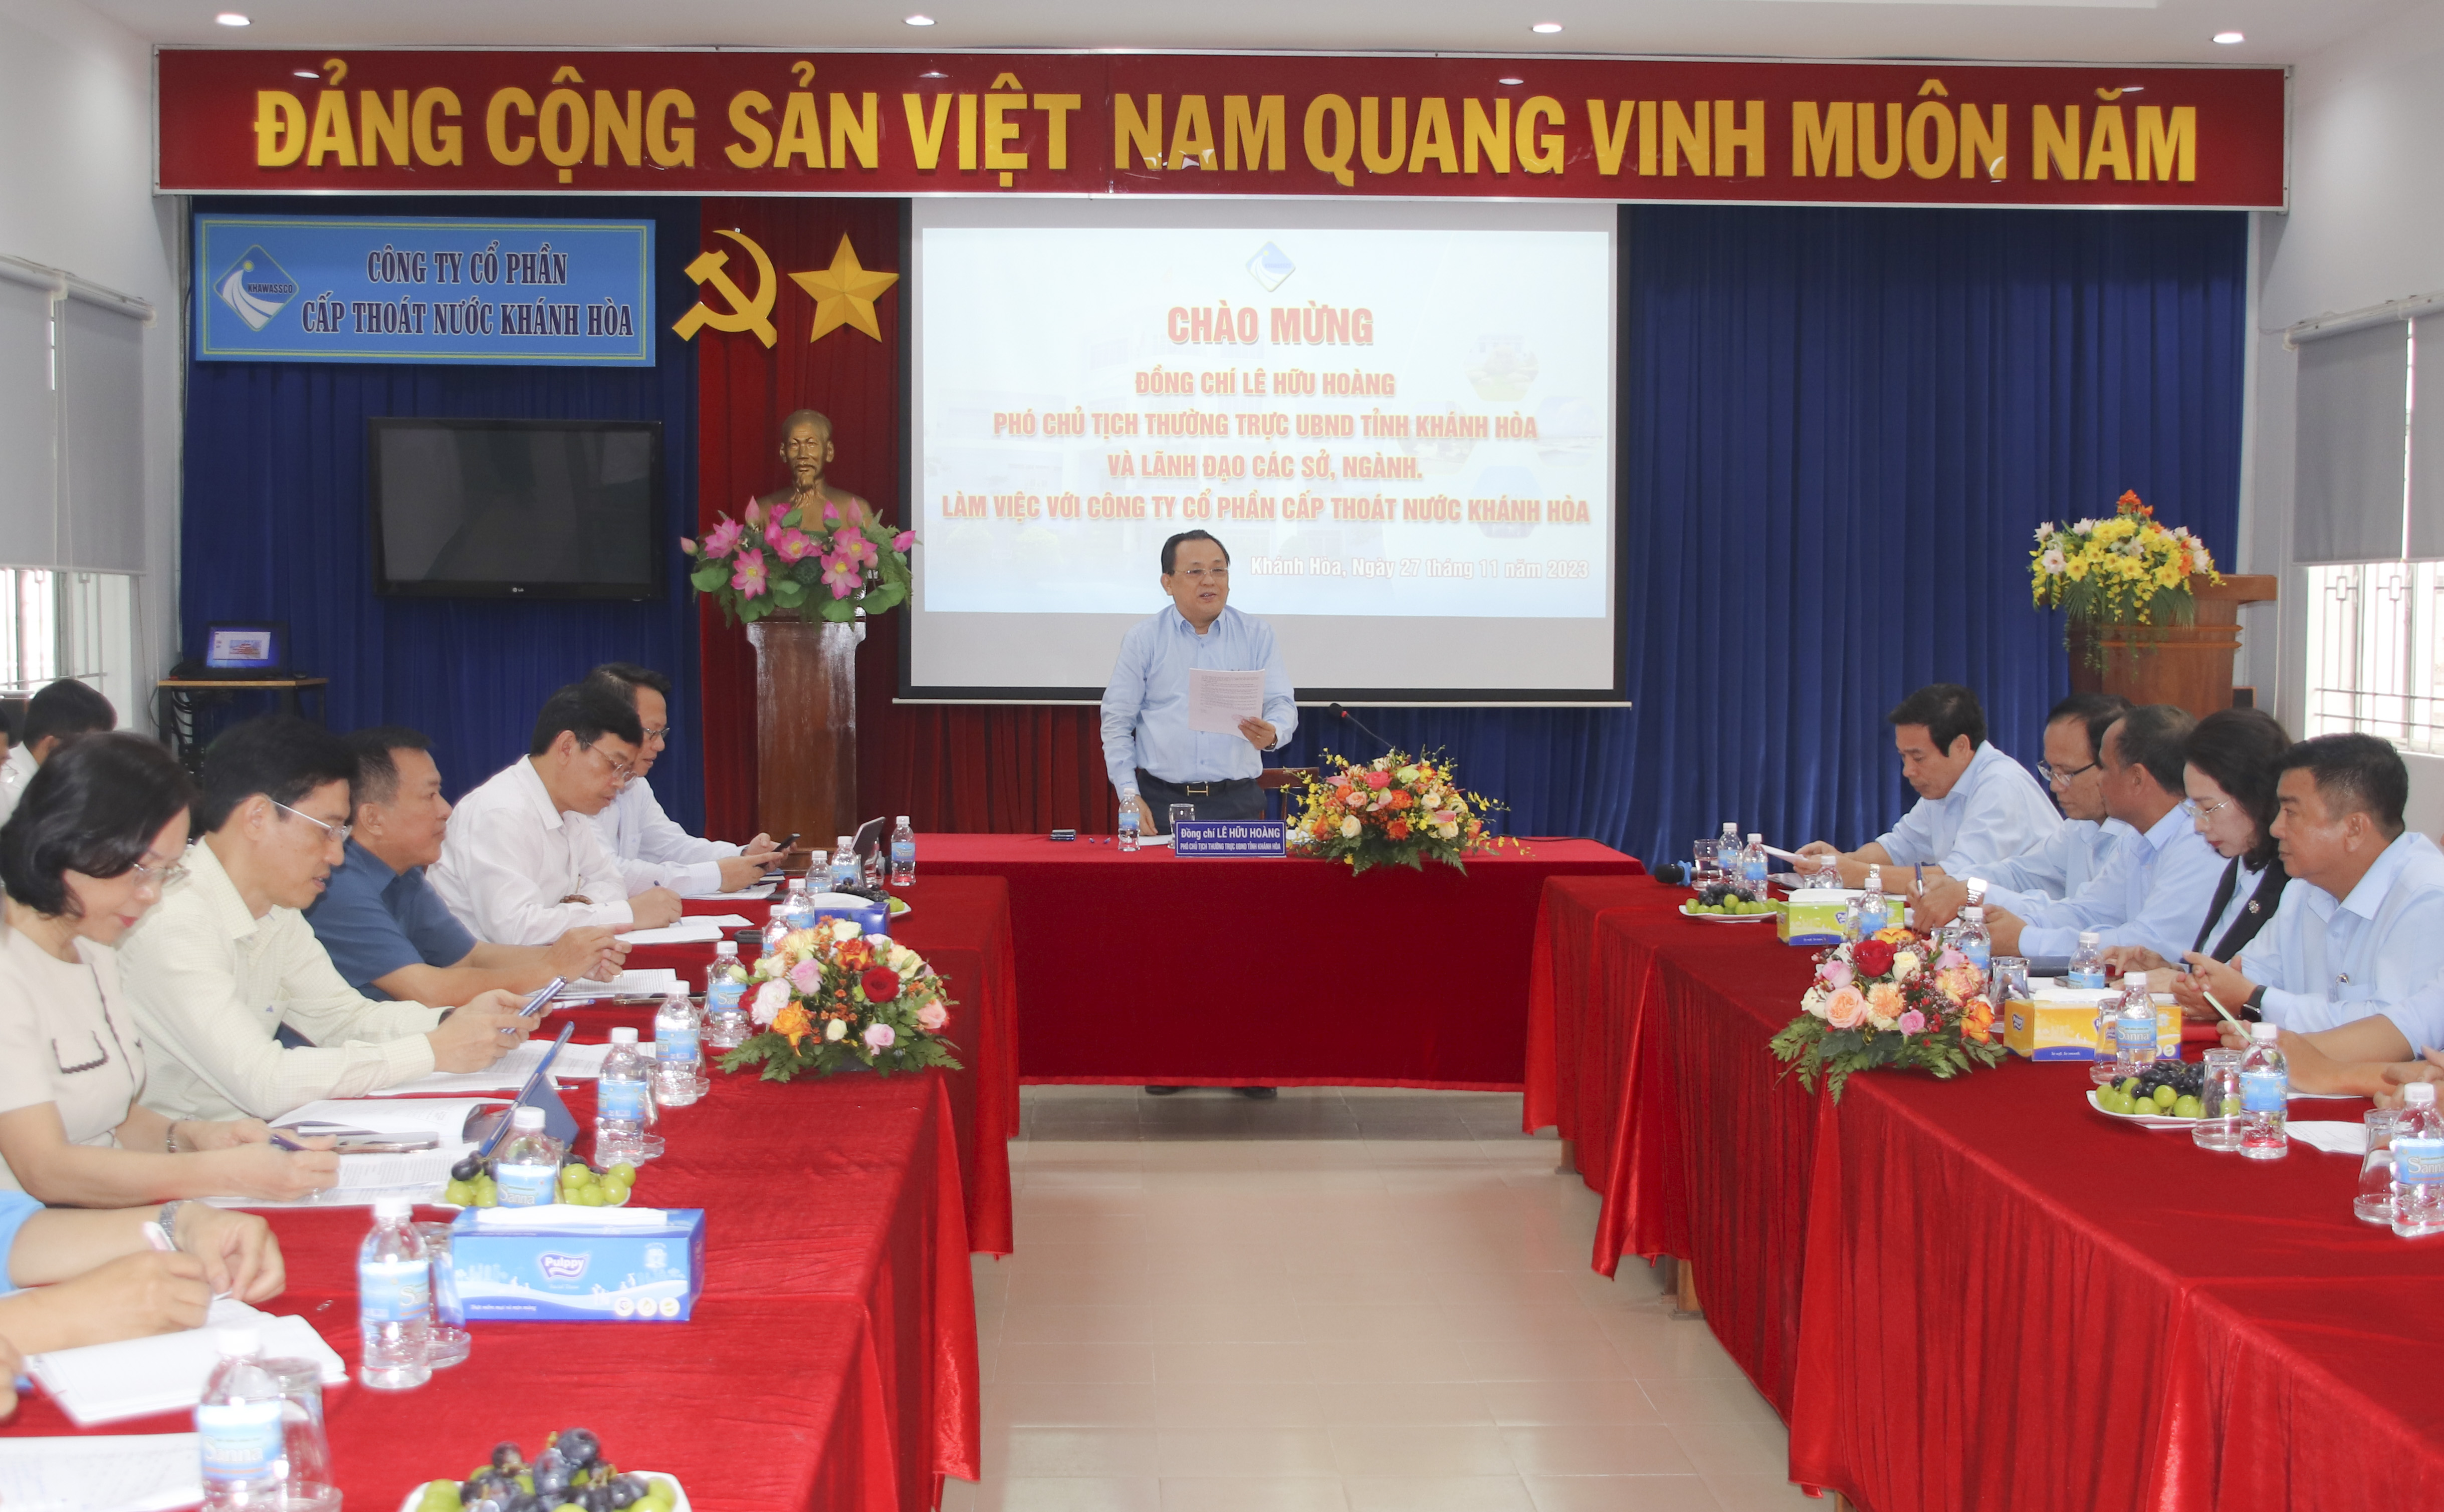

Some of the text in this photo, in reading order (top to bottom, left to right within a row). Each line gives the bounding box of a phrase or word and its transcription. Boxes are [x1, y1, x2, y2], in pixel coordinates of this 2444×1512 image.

[254, 59, 2197, 187] ĐẢNG CỘNG SẢN VIỆT NAM QUANG VINH MUÔN NĂM
[368, 241, 567, 285] CÔNG TY CỔ PHẦN
[248, 283, 293, 294] KHAWASSCO
[302, 291, 633, 336] CẤP THOÁT NƯỚC KHÁNH HÒA
[1168, 300, 1373, 344] CHÀO MỪNG
[1135, 364, 1395, 395] ĐỒNG CHÍ LÊ HỮU HOÀNG
[994, 406, 1537, 440] PHÓ CHỦ TỊCH THƯỜNG TRỰC UBND TỈNH KHÁNH HÒA
[1107, 449, 1423, 481] VÀ LÃNH ĐẠO CÁC SỞ, NGÀNH.
[943, 488, 1590, 522] LÀM VIỆC VỚI CÔNG TY CỔ PHẦN CẤP THOÁT NƯỚC KHÁNH HÒA
[1251, 557, 1589, 579] Khánh Hòa, Ngày 27 tháng 11 năm 2023
[1181, 825, 1280, 840] Đồng chí LÊ HỮU HOÀNG
[2118, 1027, 2149, 1041] Sanna
[544, 1256, 585, 1274] Pulppy
